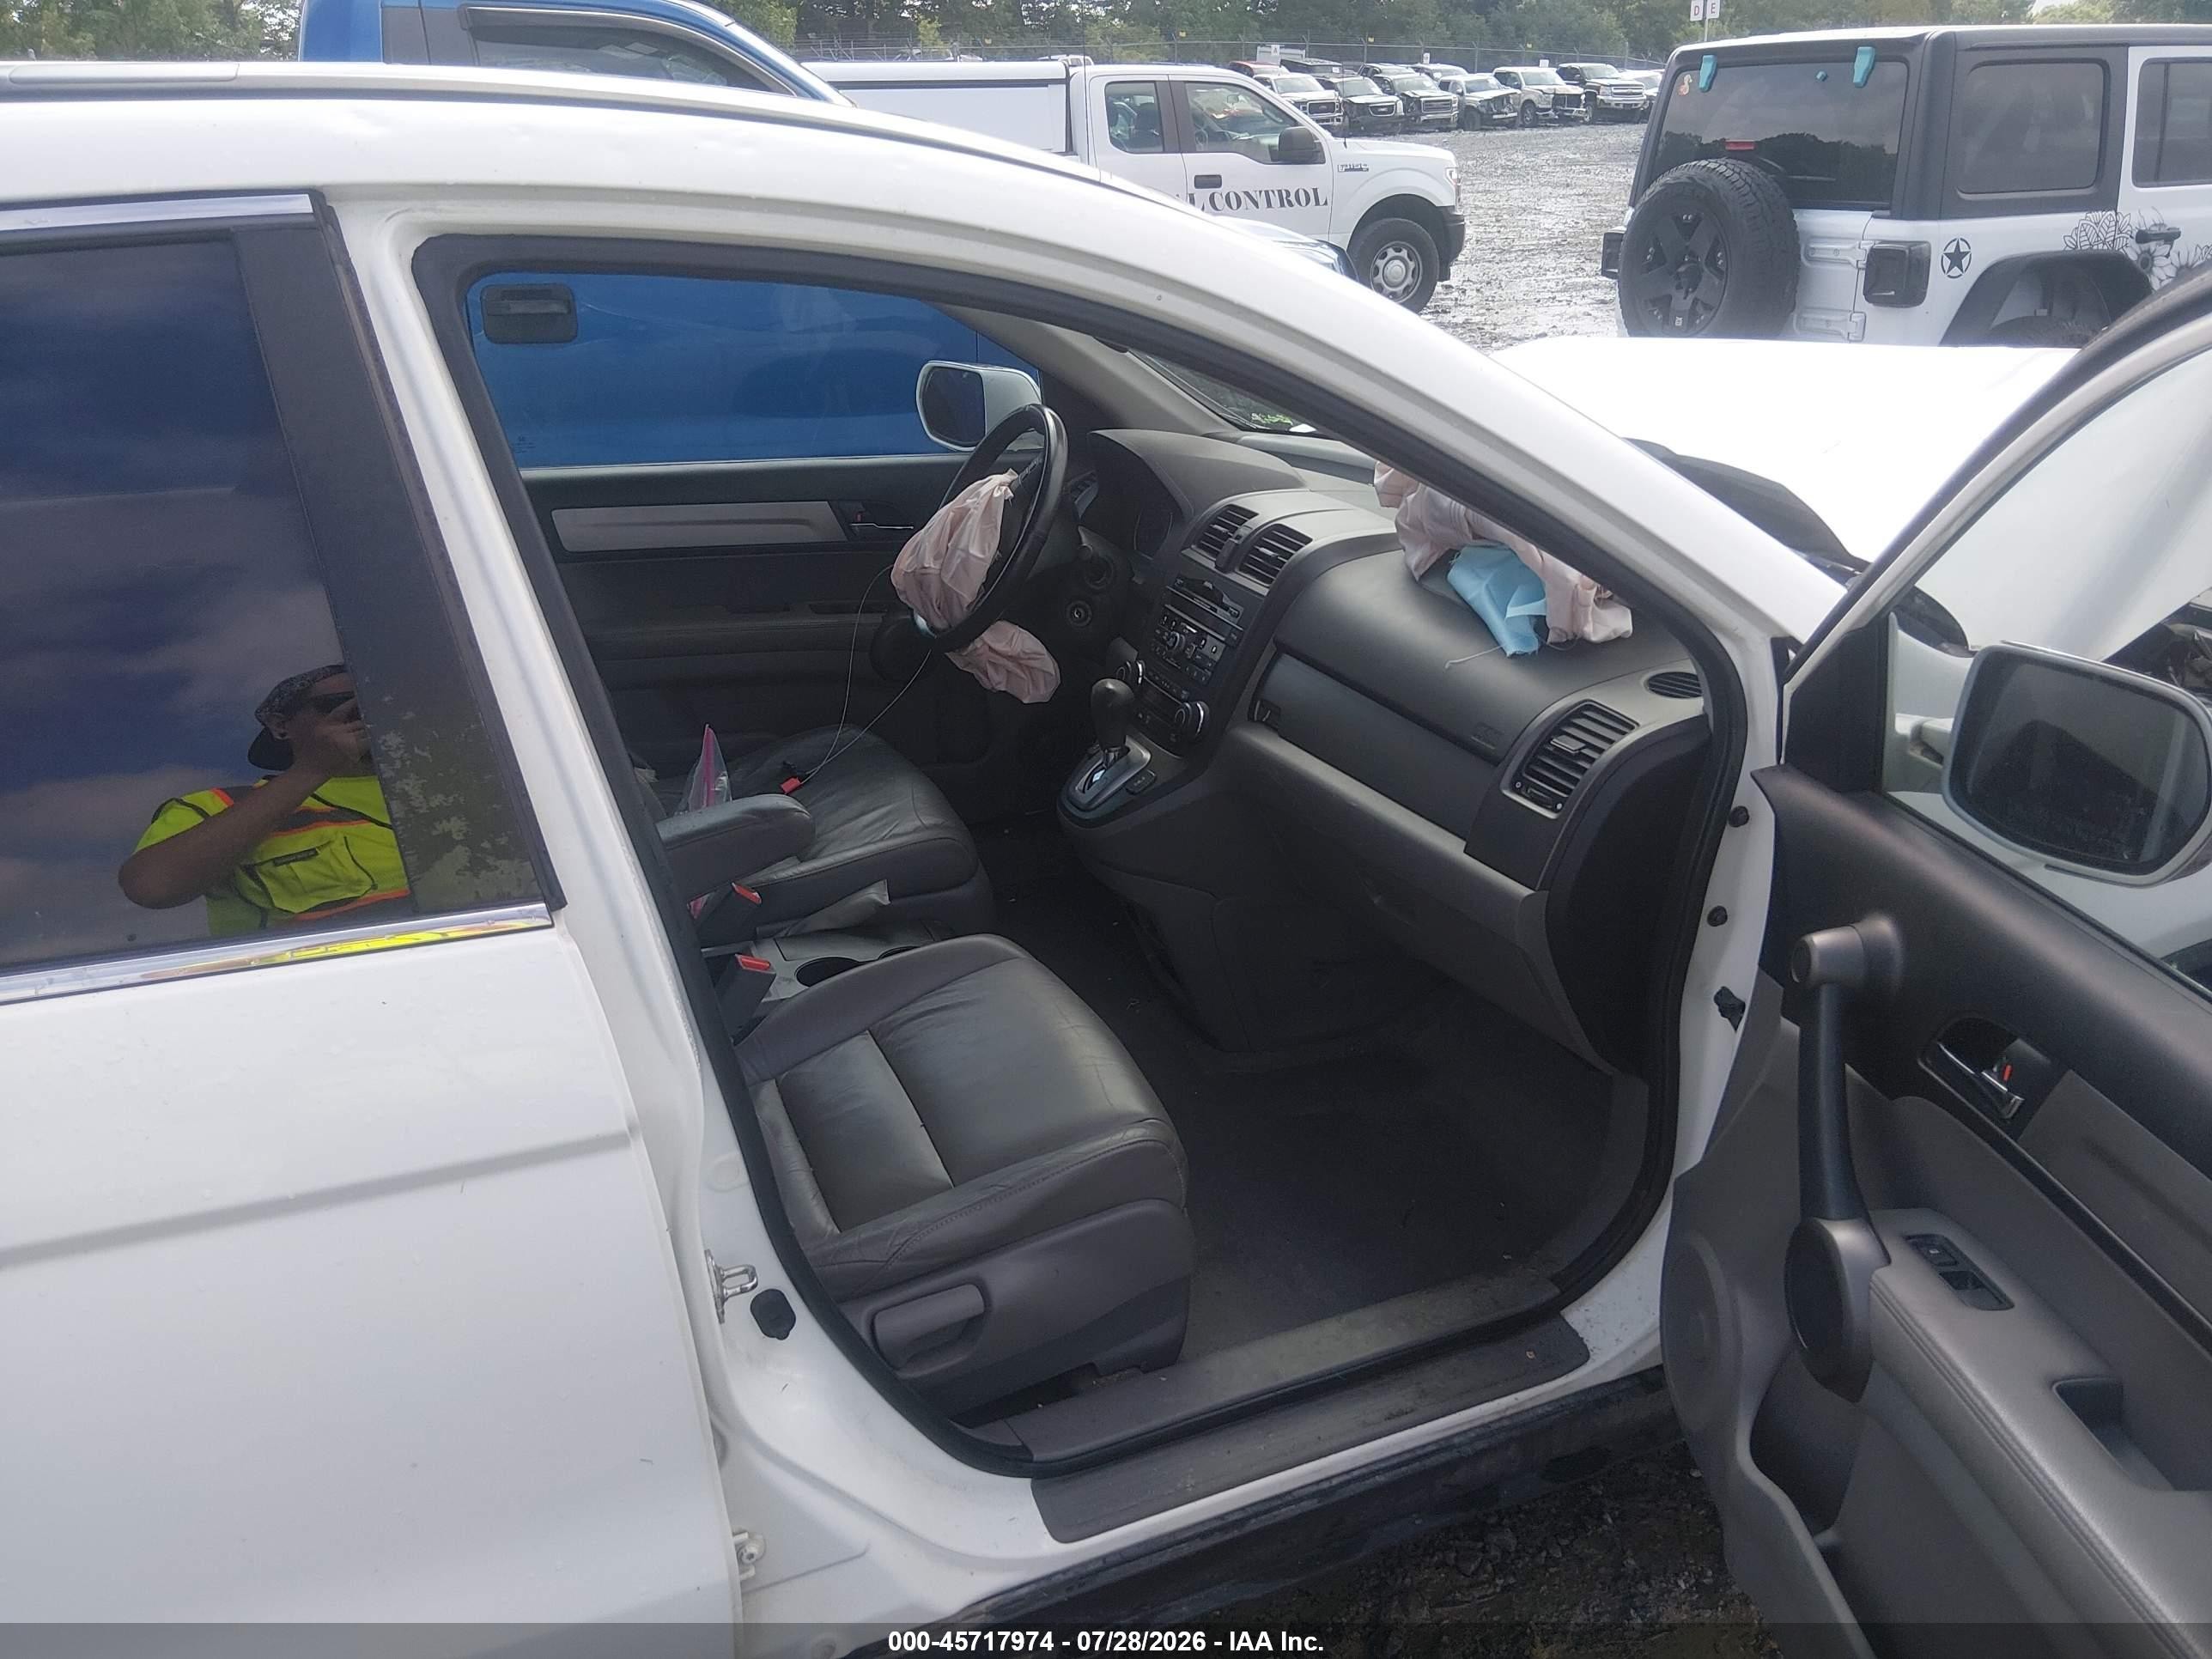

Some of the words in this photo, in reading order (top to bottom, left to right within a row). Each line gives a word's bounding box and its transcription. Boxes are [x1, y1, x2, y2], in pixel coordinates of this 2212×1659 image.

[1693, 5, 1700, 15] D
[1711, 3, 1717, 14] E
[1208, 187, 1328, 211] CONTROL
